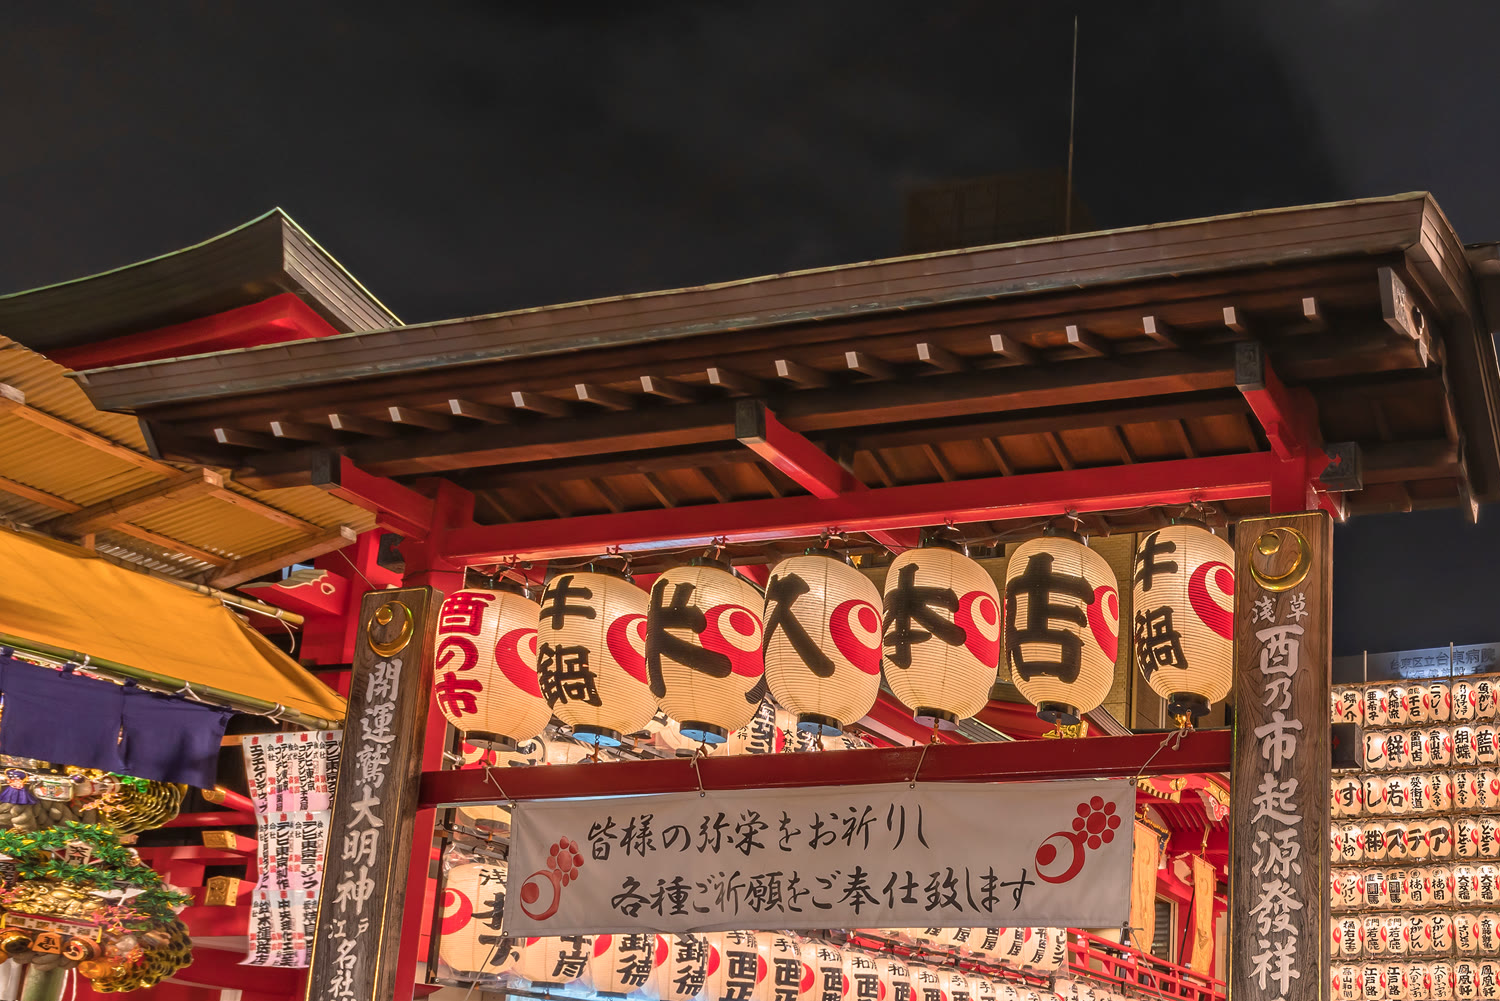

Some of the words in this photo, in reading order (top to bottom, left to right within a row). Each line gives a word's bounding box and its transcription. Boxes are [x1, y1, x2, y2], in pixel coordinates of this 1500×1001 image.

[537, 574, 602, 707] 牛鍋
[1134, 531, 1188, 683] 牛鍋
[1252, 592, 1309, 624] 浅草
[435, 591, 496, 719] 酉の市
[586, 802, 931, 862] 皆様の弥栄をお祈りし
[610, 866, 1036, 917] 各種ご祈願をご奉仕致します
